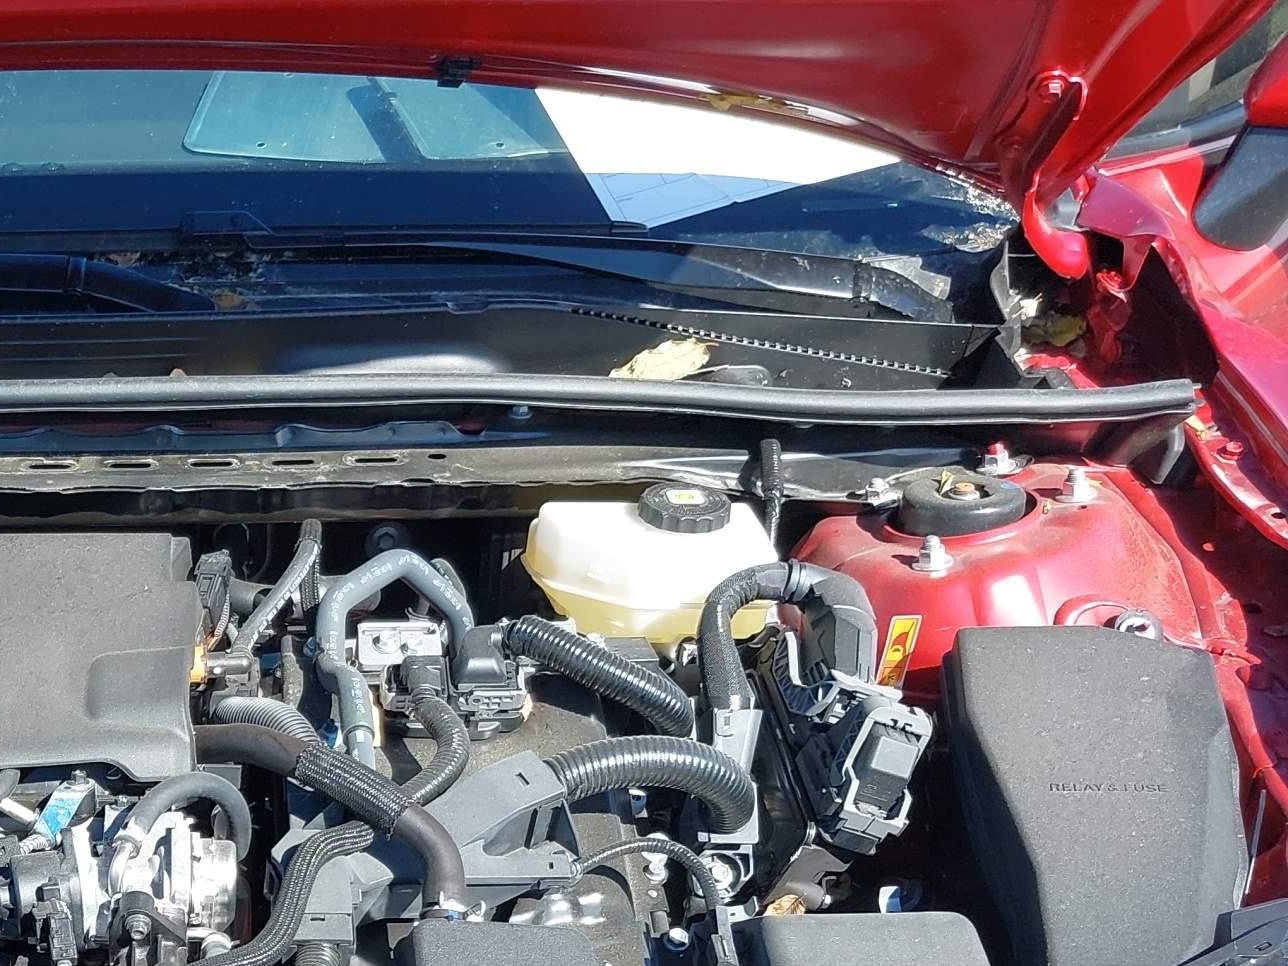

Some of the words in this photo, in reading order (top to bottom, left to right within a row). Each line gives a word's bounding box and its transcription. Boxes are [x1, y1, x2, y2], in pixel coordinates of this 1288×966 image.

[1049, 783, 1103, 792] RELAY
[1107, 783, 1120, 792] &
[1124, 783, 1170, 793] FUSE
